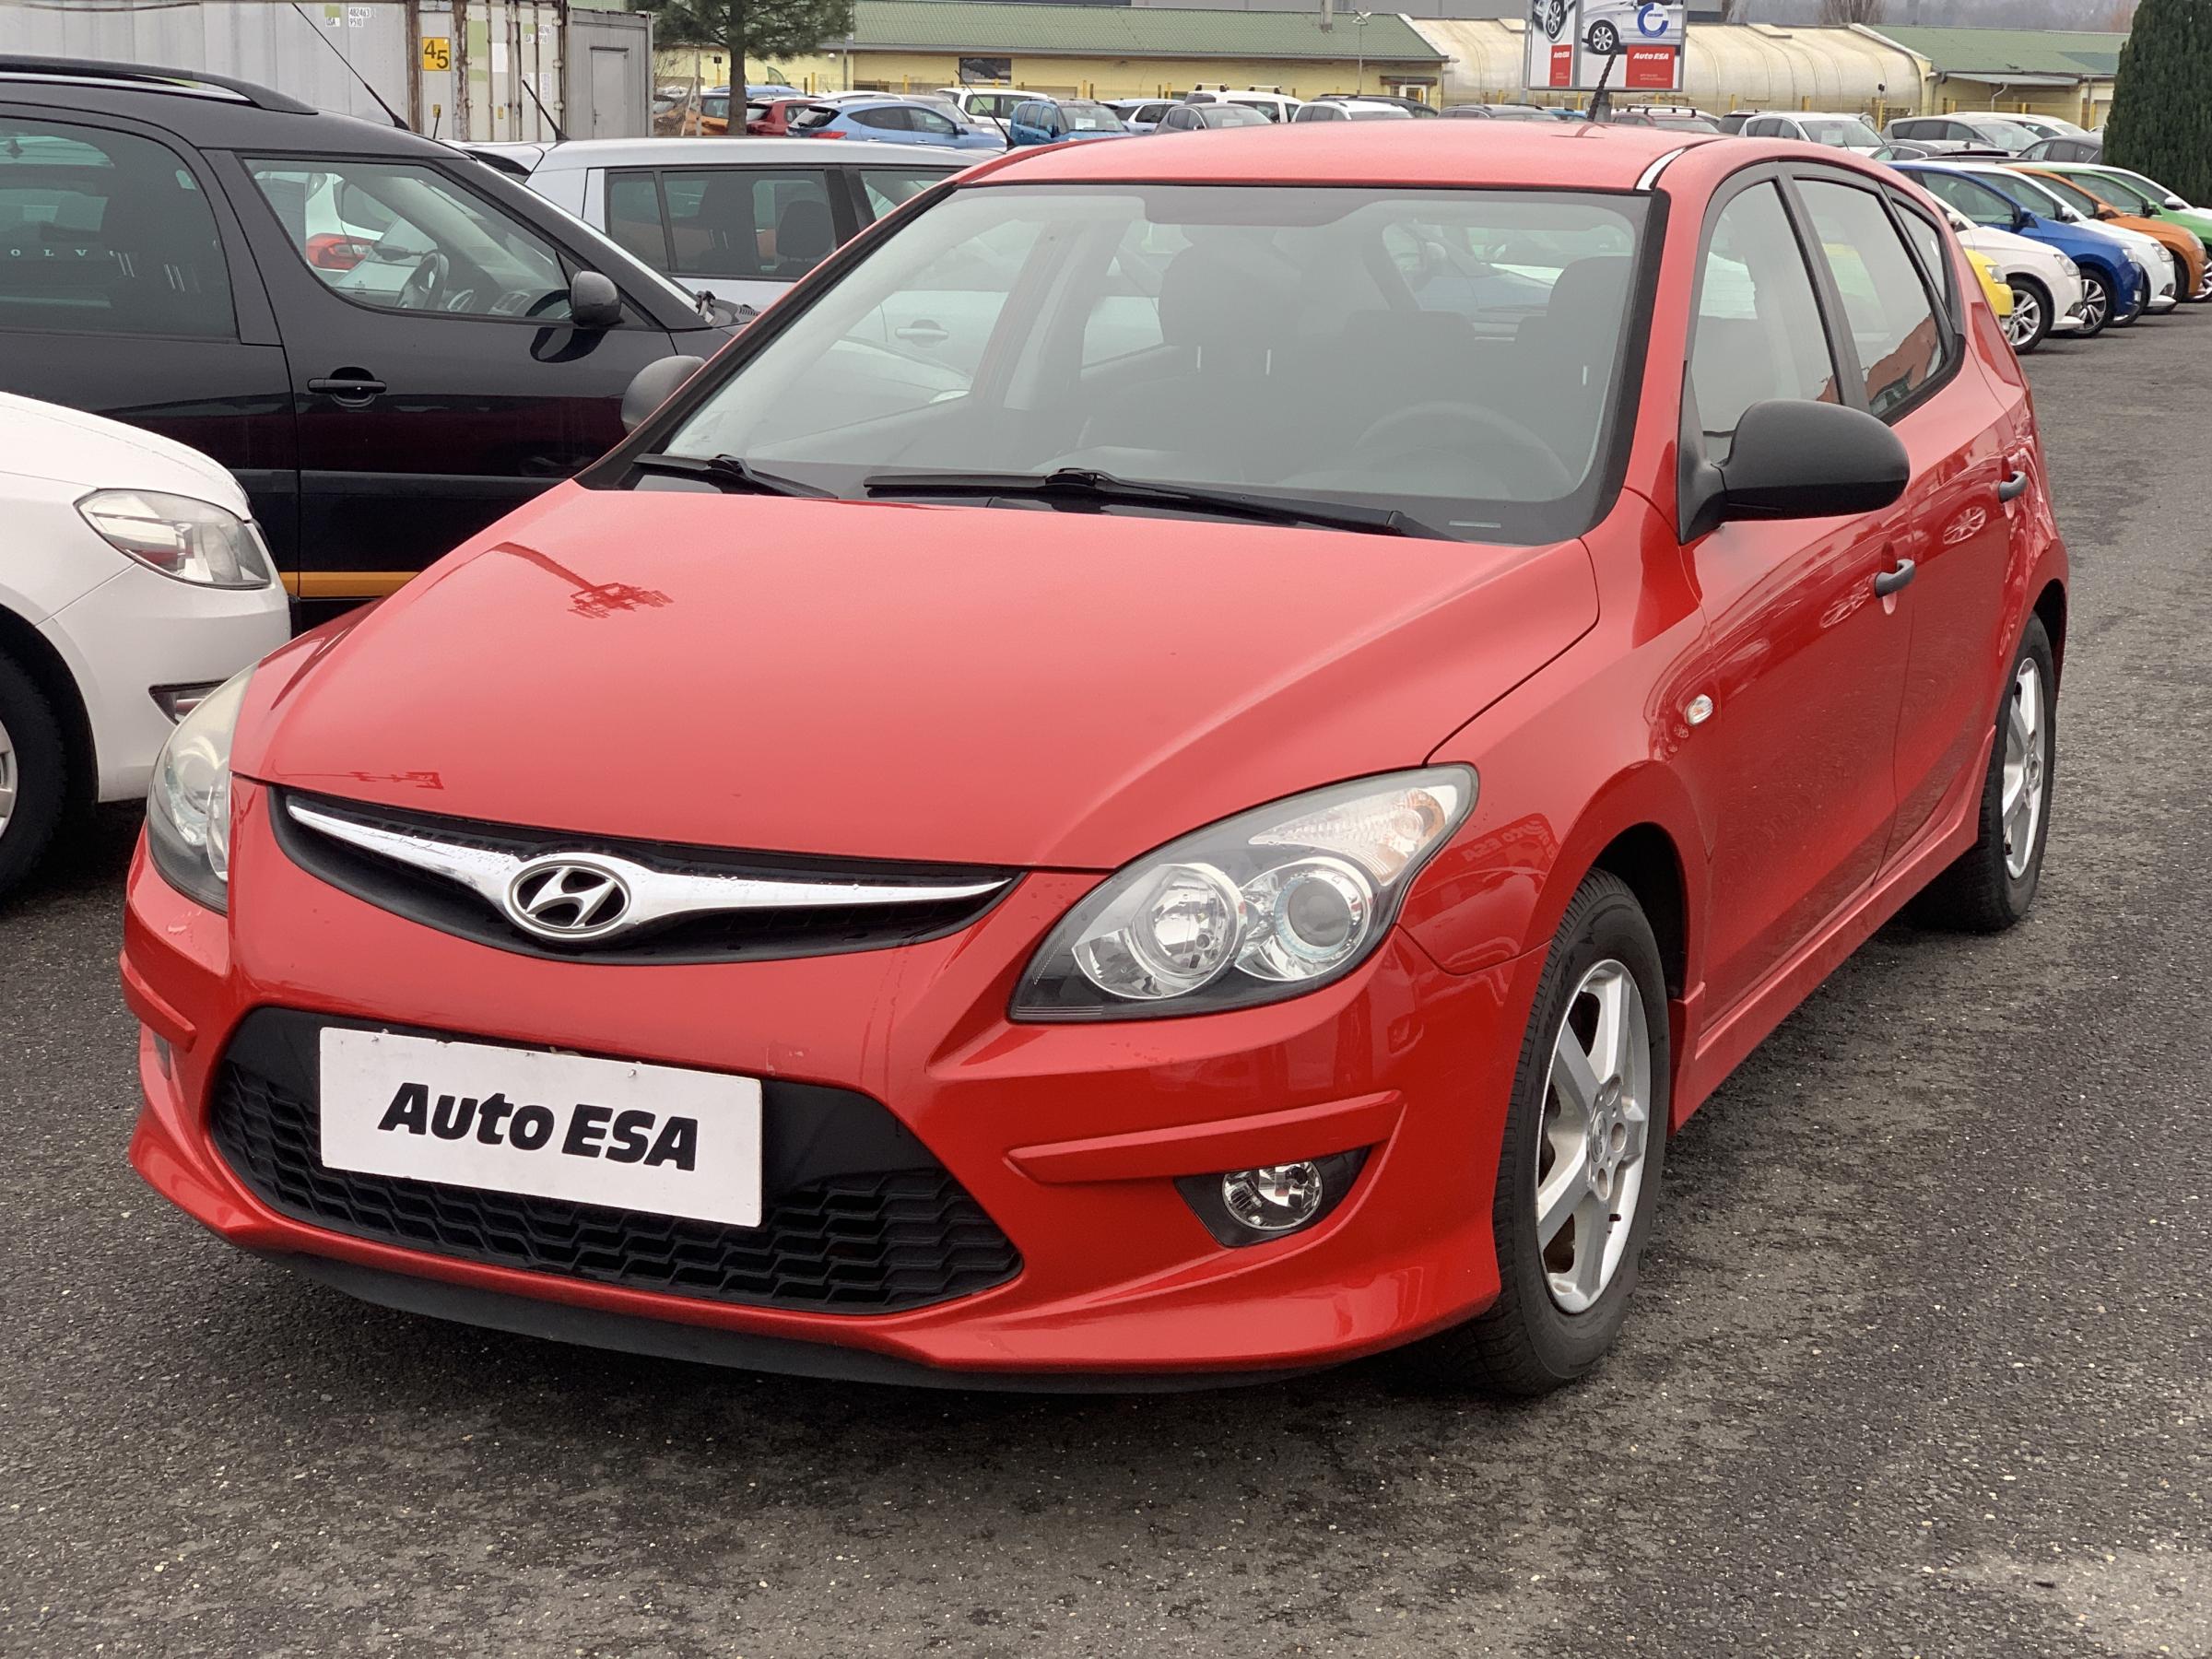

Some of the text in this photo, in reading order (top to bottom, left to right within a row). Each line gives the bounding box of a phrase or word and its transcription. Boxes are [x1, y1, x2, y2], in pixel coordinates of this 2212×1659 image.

[424, 40, 449, 69] 45
[1633, 52, 1653, 60] Auto
[378, 1082, 699, 1171] Auto ESA
